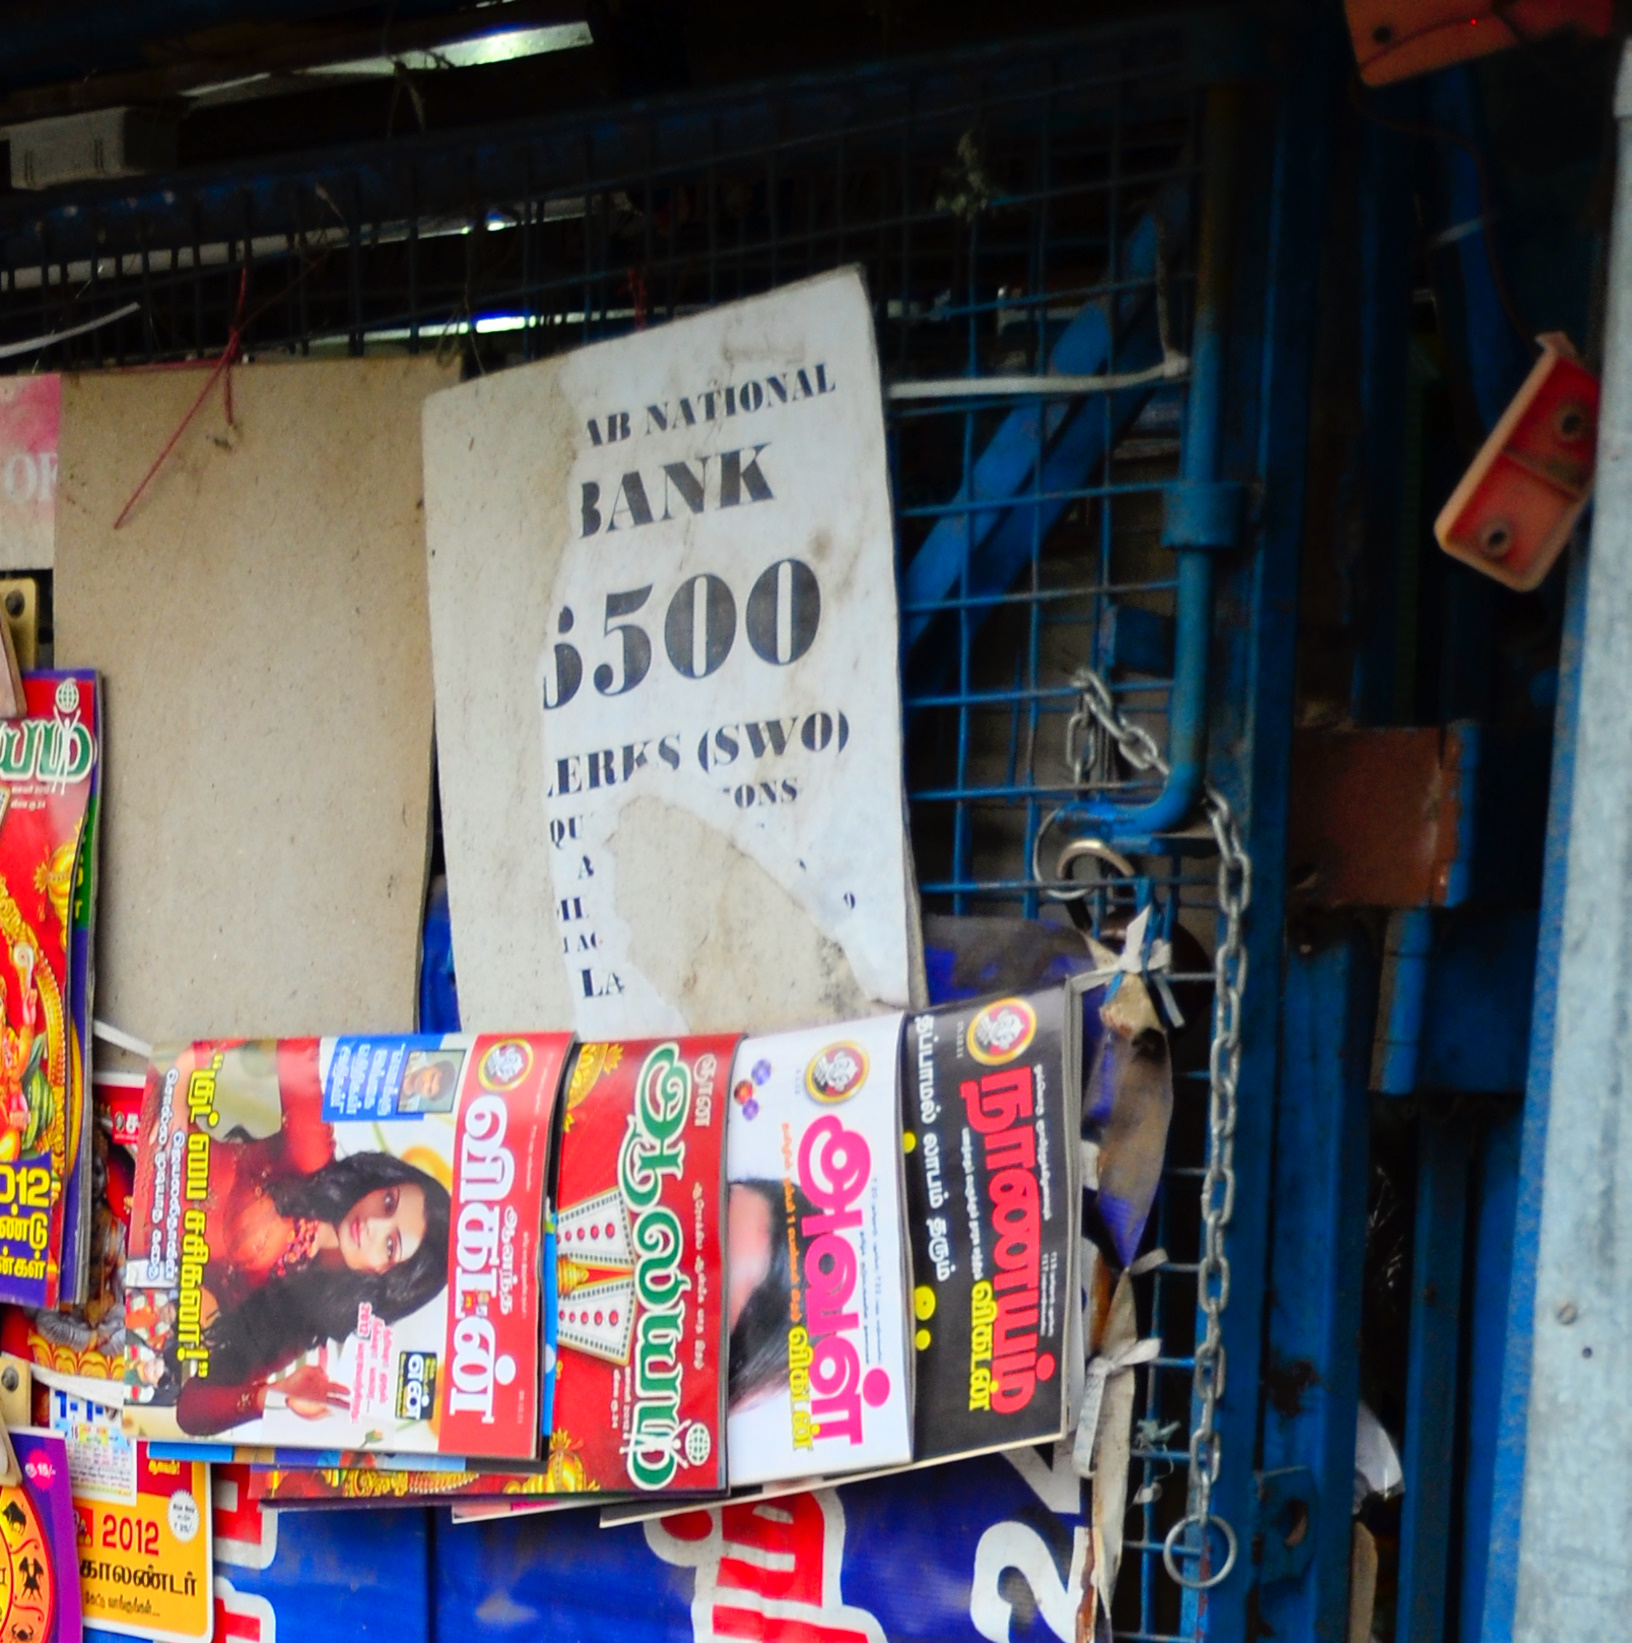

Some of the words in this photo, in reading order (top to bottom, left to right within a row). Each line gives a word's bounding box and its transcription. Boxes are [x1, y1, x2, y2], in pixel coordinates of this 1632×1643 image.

[645, 362, 837, 437] NATIONAL
[4, 452, 59, 502] OF
[698, 709, 849, 775] (SWO)
[695, 1053, 717, 1128] ஞான
[915, 1015, 942, 1126] தப்பாமல்
[924, 1134, 947, 1208] லாபம்
[450, 1094, 516, 1424] விகடன்
[499, 1206, 517, 1316] ஆனந்த
[927, 1216, 956, 1282] தரும்
[962, 1065, 1056, 1414] நாணயம்
[798, 1114, 892, 1446] அவள்
[970, 1278, 996, 1412] விகடன்
[788, 1325, 814, 1452] விகடன்
[102, 1514, 161, 1556] 2012
[81, 1551, 198, 1599] காலண்டர்
